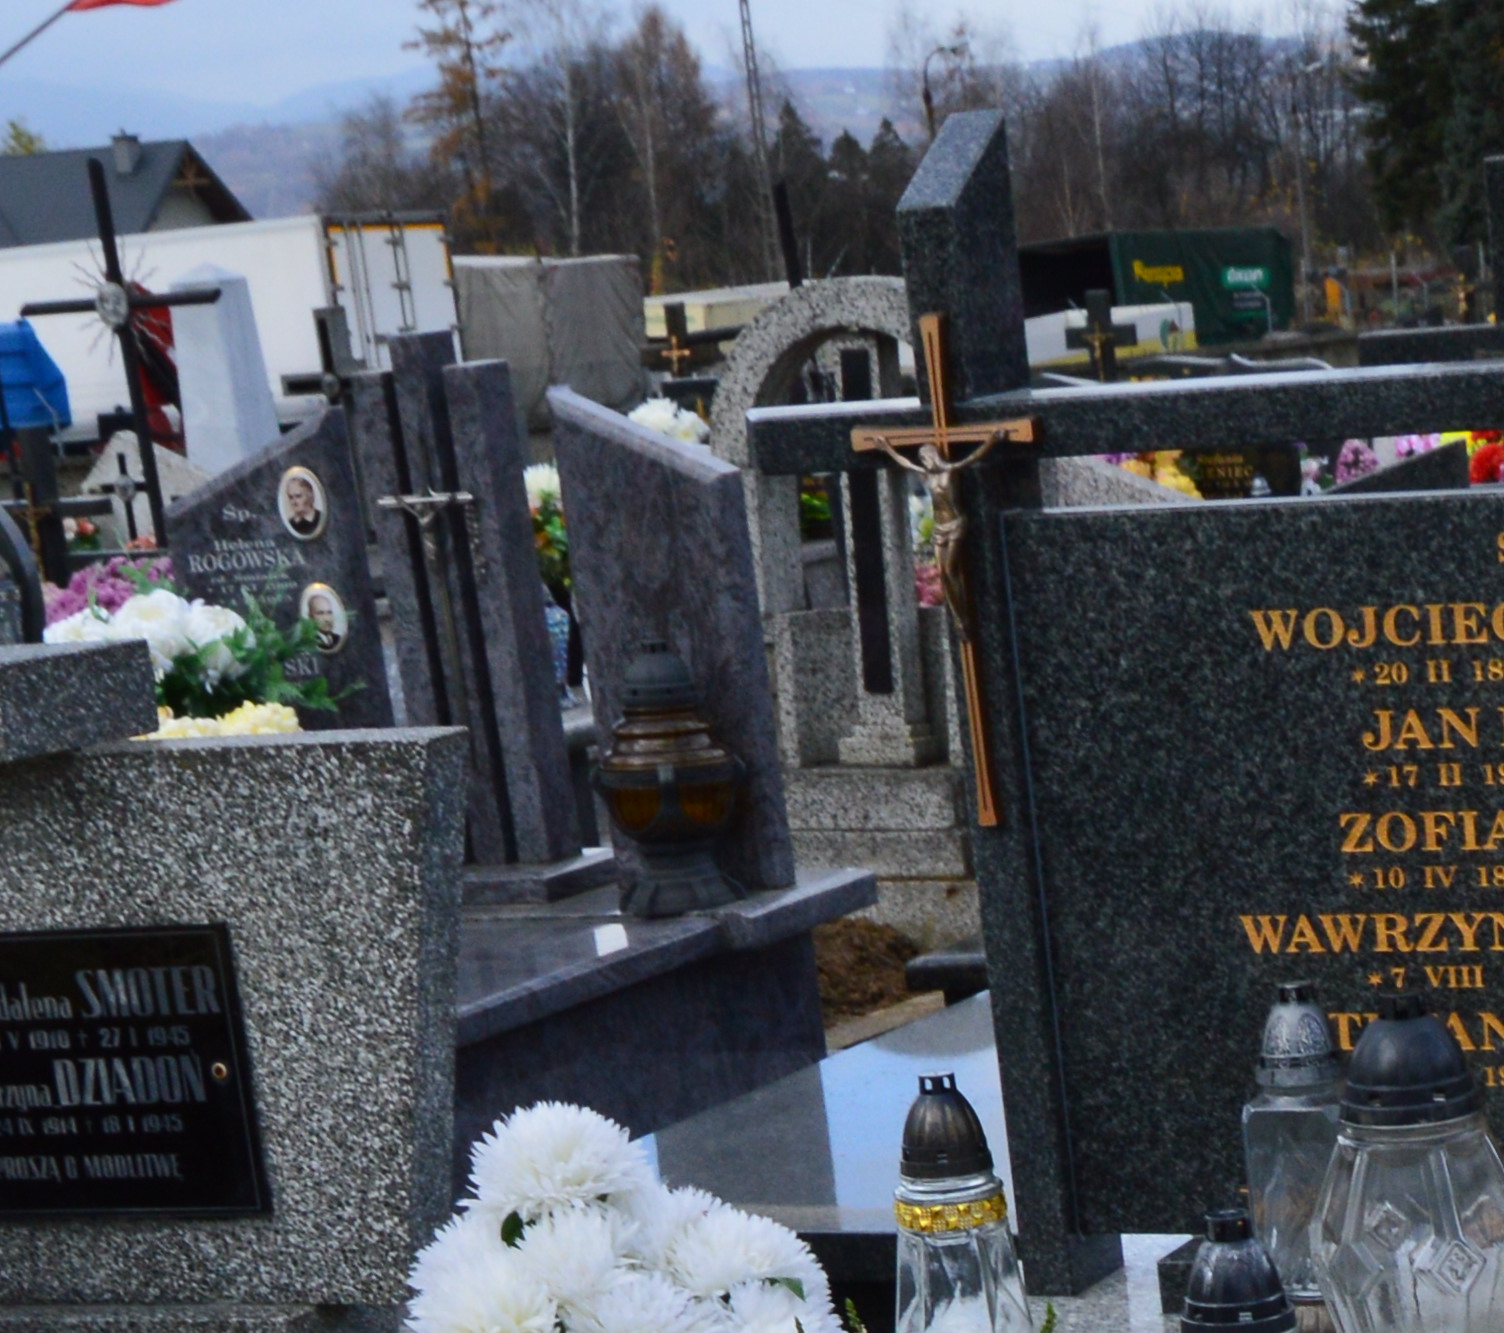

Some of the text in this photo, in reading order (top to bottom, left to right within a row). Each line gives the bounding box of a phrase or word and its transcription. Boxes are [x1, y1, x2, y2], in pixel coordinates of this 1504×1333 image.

[188, 546, 307, 574] ROGOWSKA
[1375, 664, 1408, 684] 20
[1428, 660, 1450, 682] II
[1363, 708, 1479, 751] JAN
[1389, 765, 1417, 786] 17
[1439, 764, 1461, 786] II
[1375, 867, 1404, 888] 10
[1425, 866, 1456, 888] IV
[1391, 968, 1405, 986] 7
[1425, 966, 1484, 987] VIII
[75, 965, 221, 1019] SMOTER
